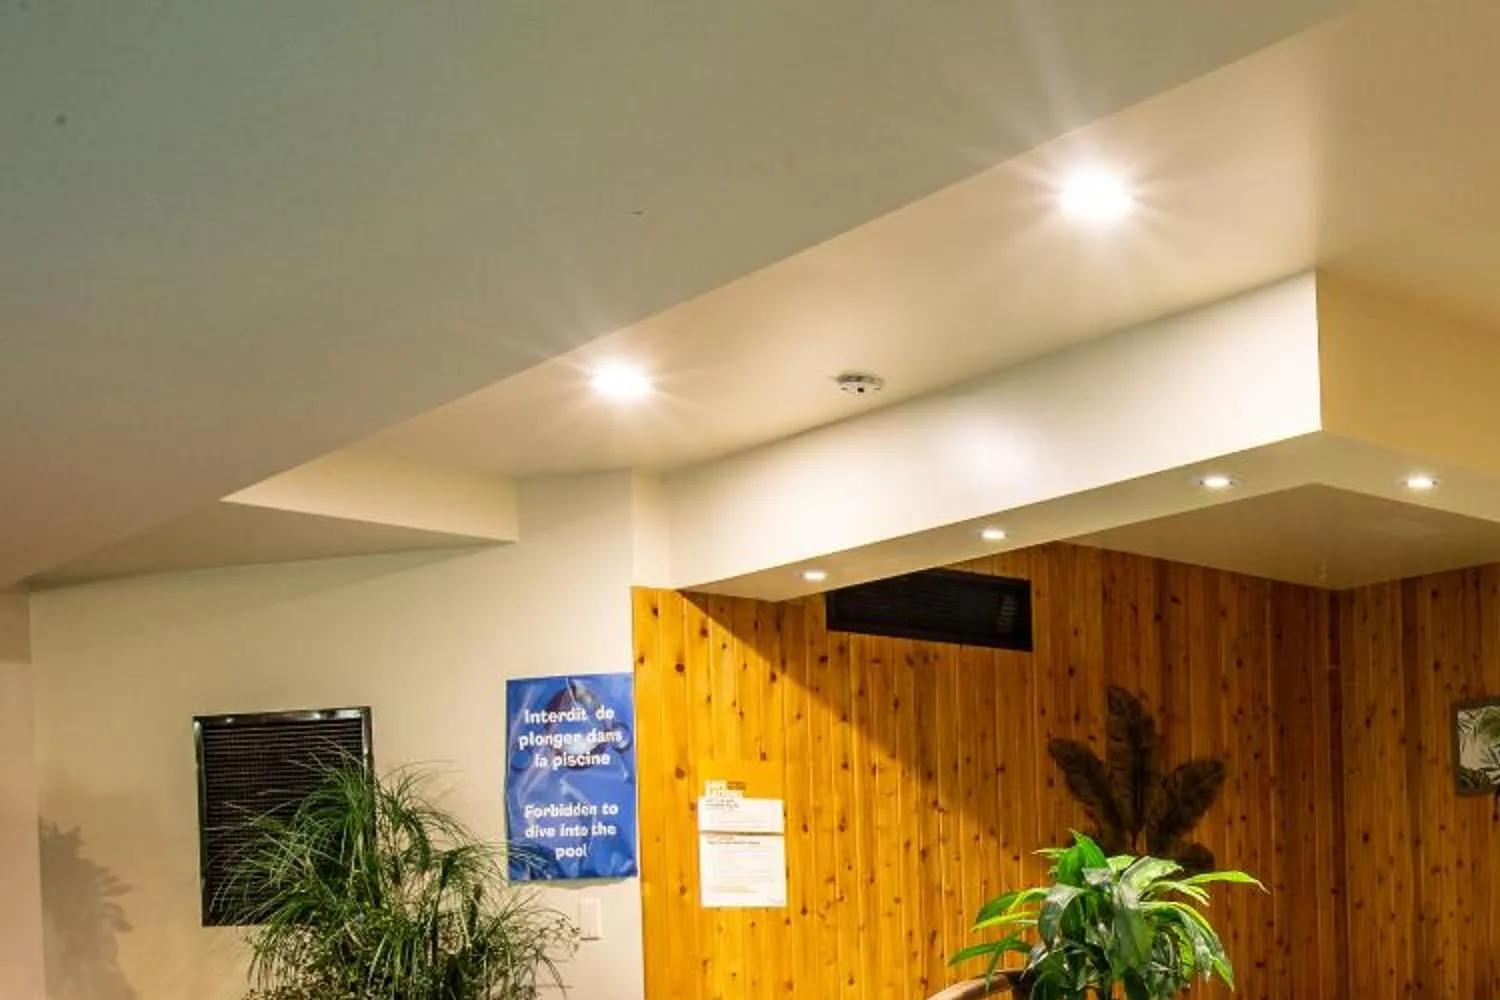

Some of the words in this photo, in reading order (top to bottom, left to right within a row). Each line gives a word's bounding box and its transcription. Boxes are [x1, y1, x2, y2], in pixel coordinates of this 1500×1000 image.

[524, 706, 588, 724] Interdit
[595, 704, 615, 720] de
[519, 730, 581, 750] plonger
[587, 728, 622, 743] dans
[534, 753, 549, 768] la
[552, 752, 611, 770] piscine
[524, 801, 598, 818] Forbidden
[602, 803, 619, 815] to
[525, 823, 557, 838] dive
[560, 823, 588, 837] into
[591, 821, 617, 836] the
[555, 843, 588, 861] pool
